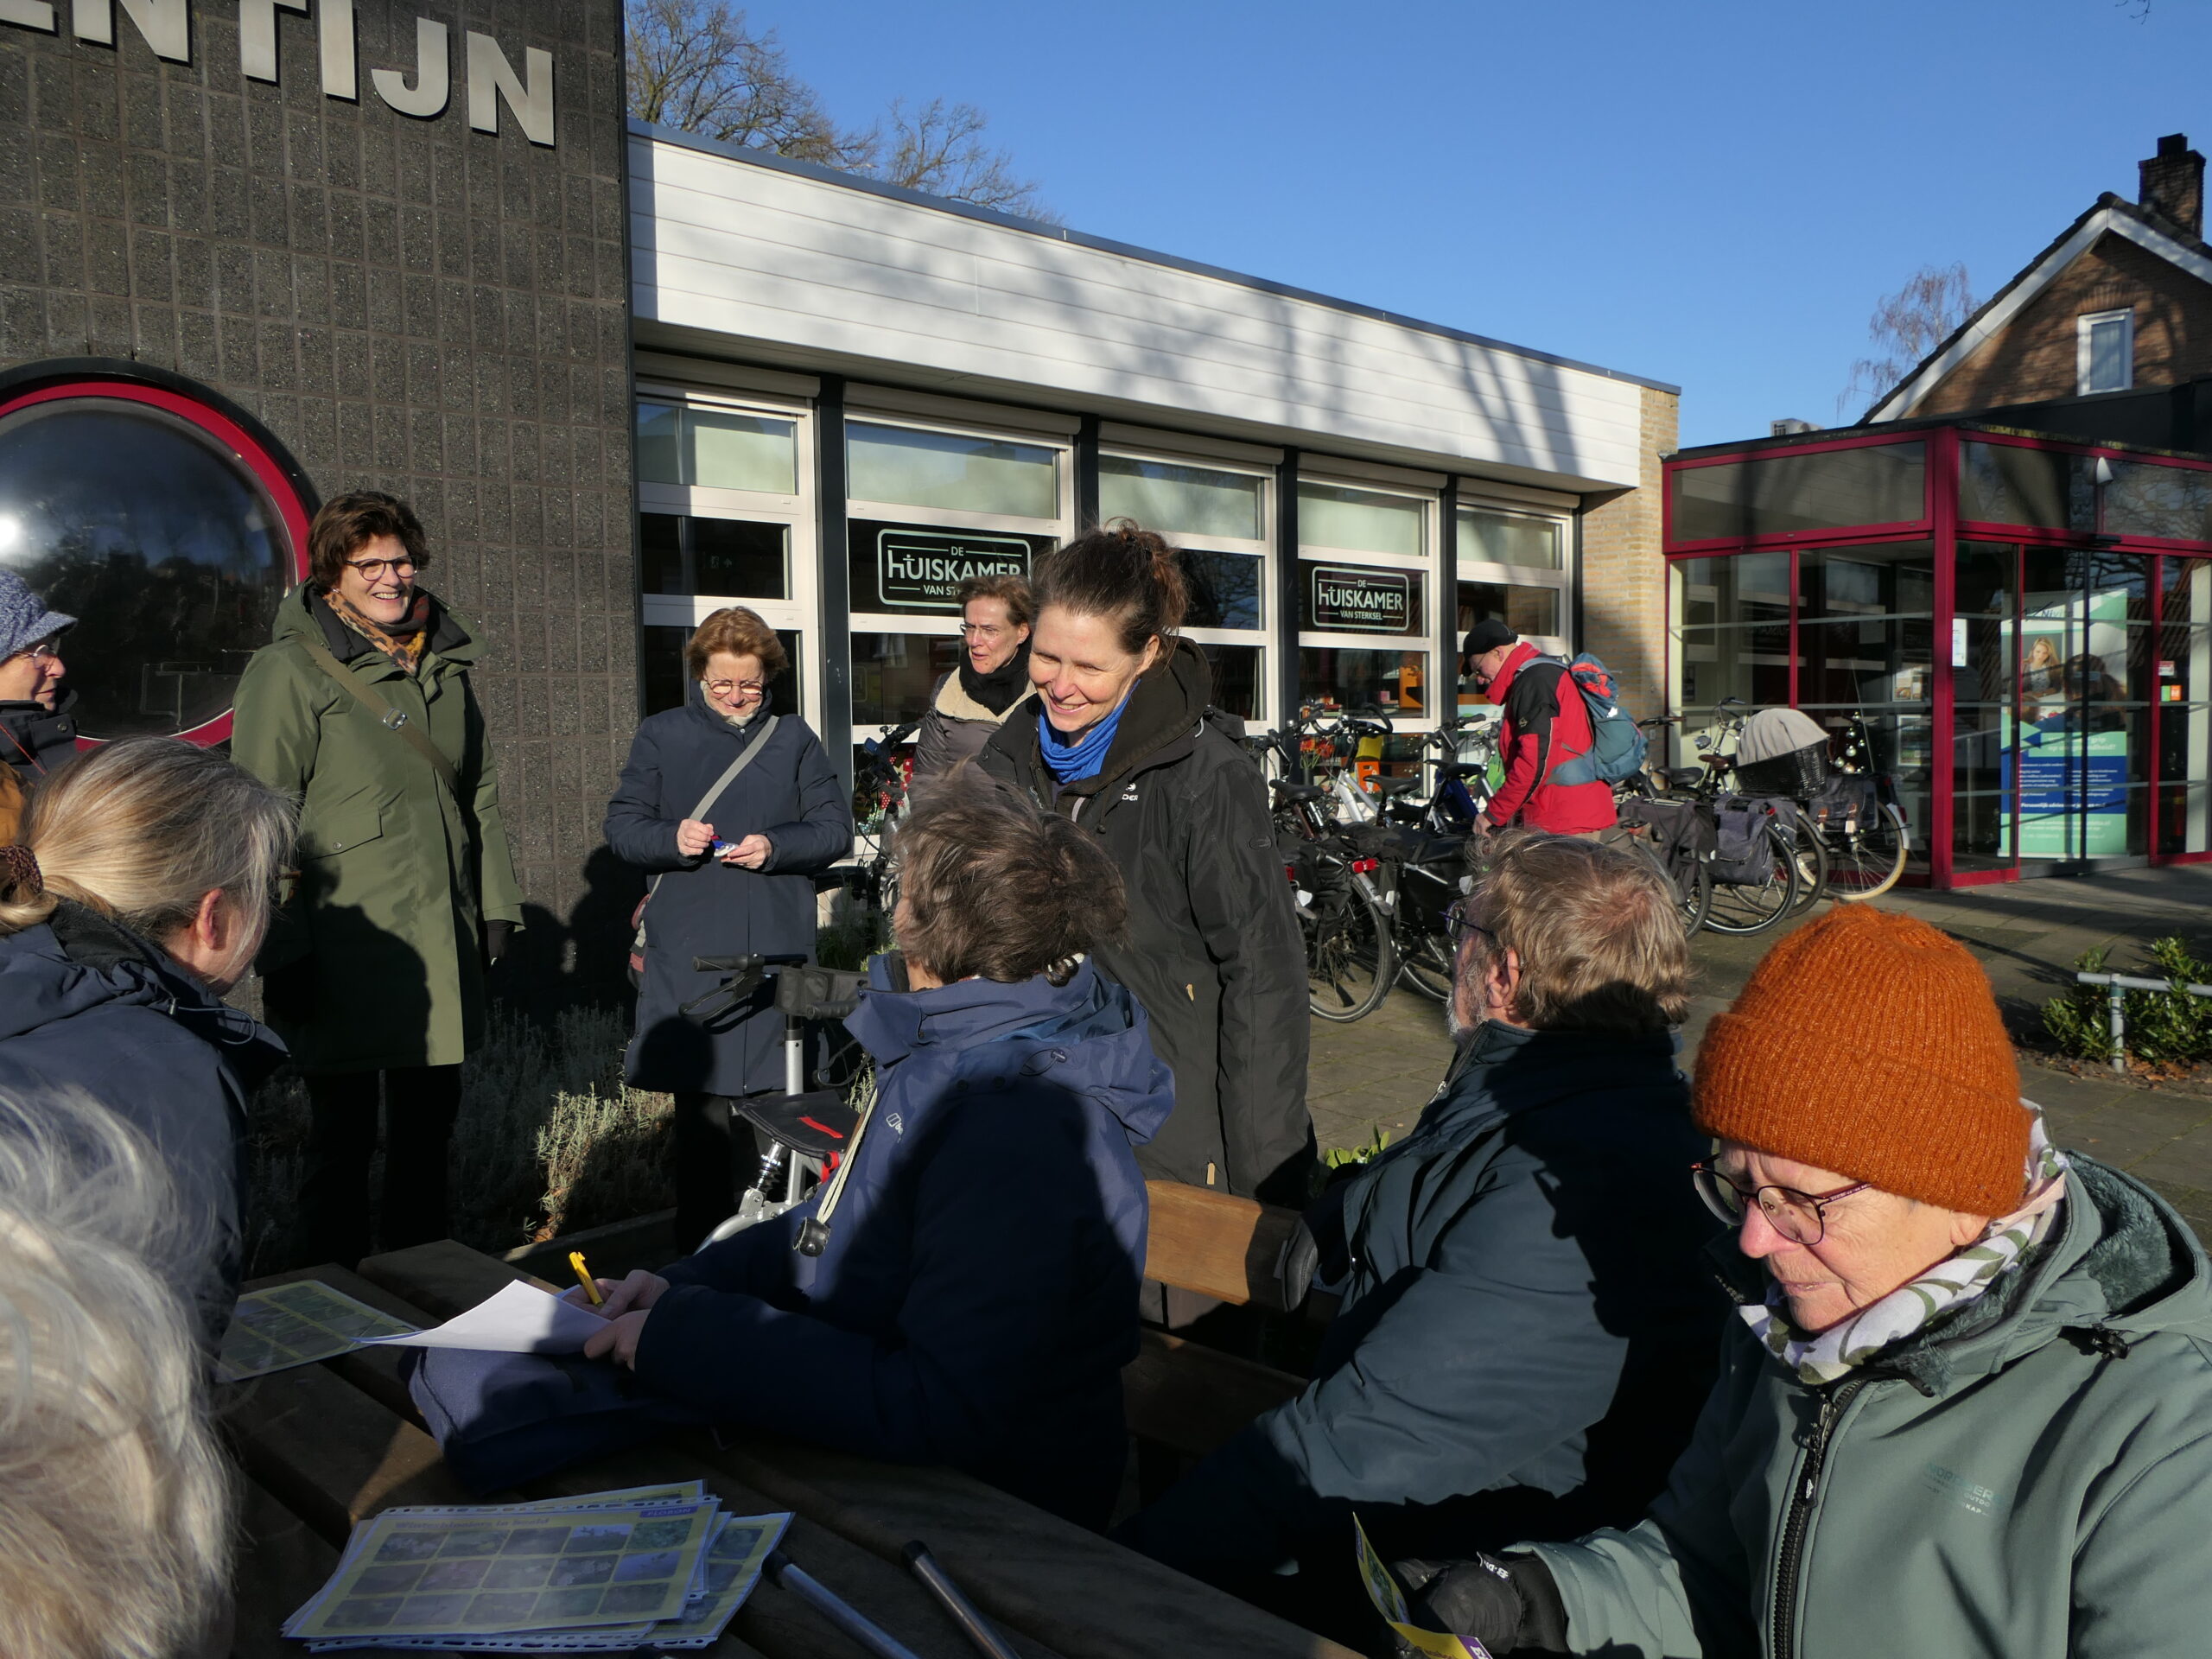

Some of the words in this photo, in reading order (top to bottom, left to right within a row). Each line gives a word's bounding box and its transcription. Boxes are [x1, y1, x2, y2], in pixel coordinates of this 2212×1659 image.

[950, 546, 964, 556] DE
[1357, 579, 1367, 588] DE
[923, 585, 944, 596] VAN
[1340, 610, 1353, 619] VAN
[1354, 612, 1382, 620] STERKSEL
